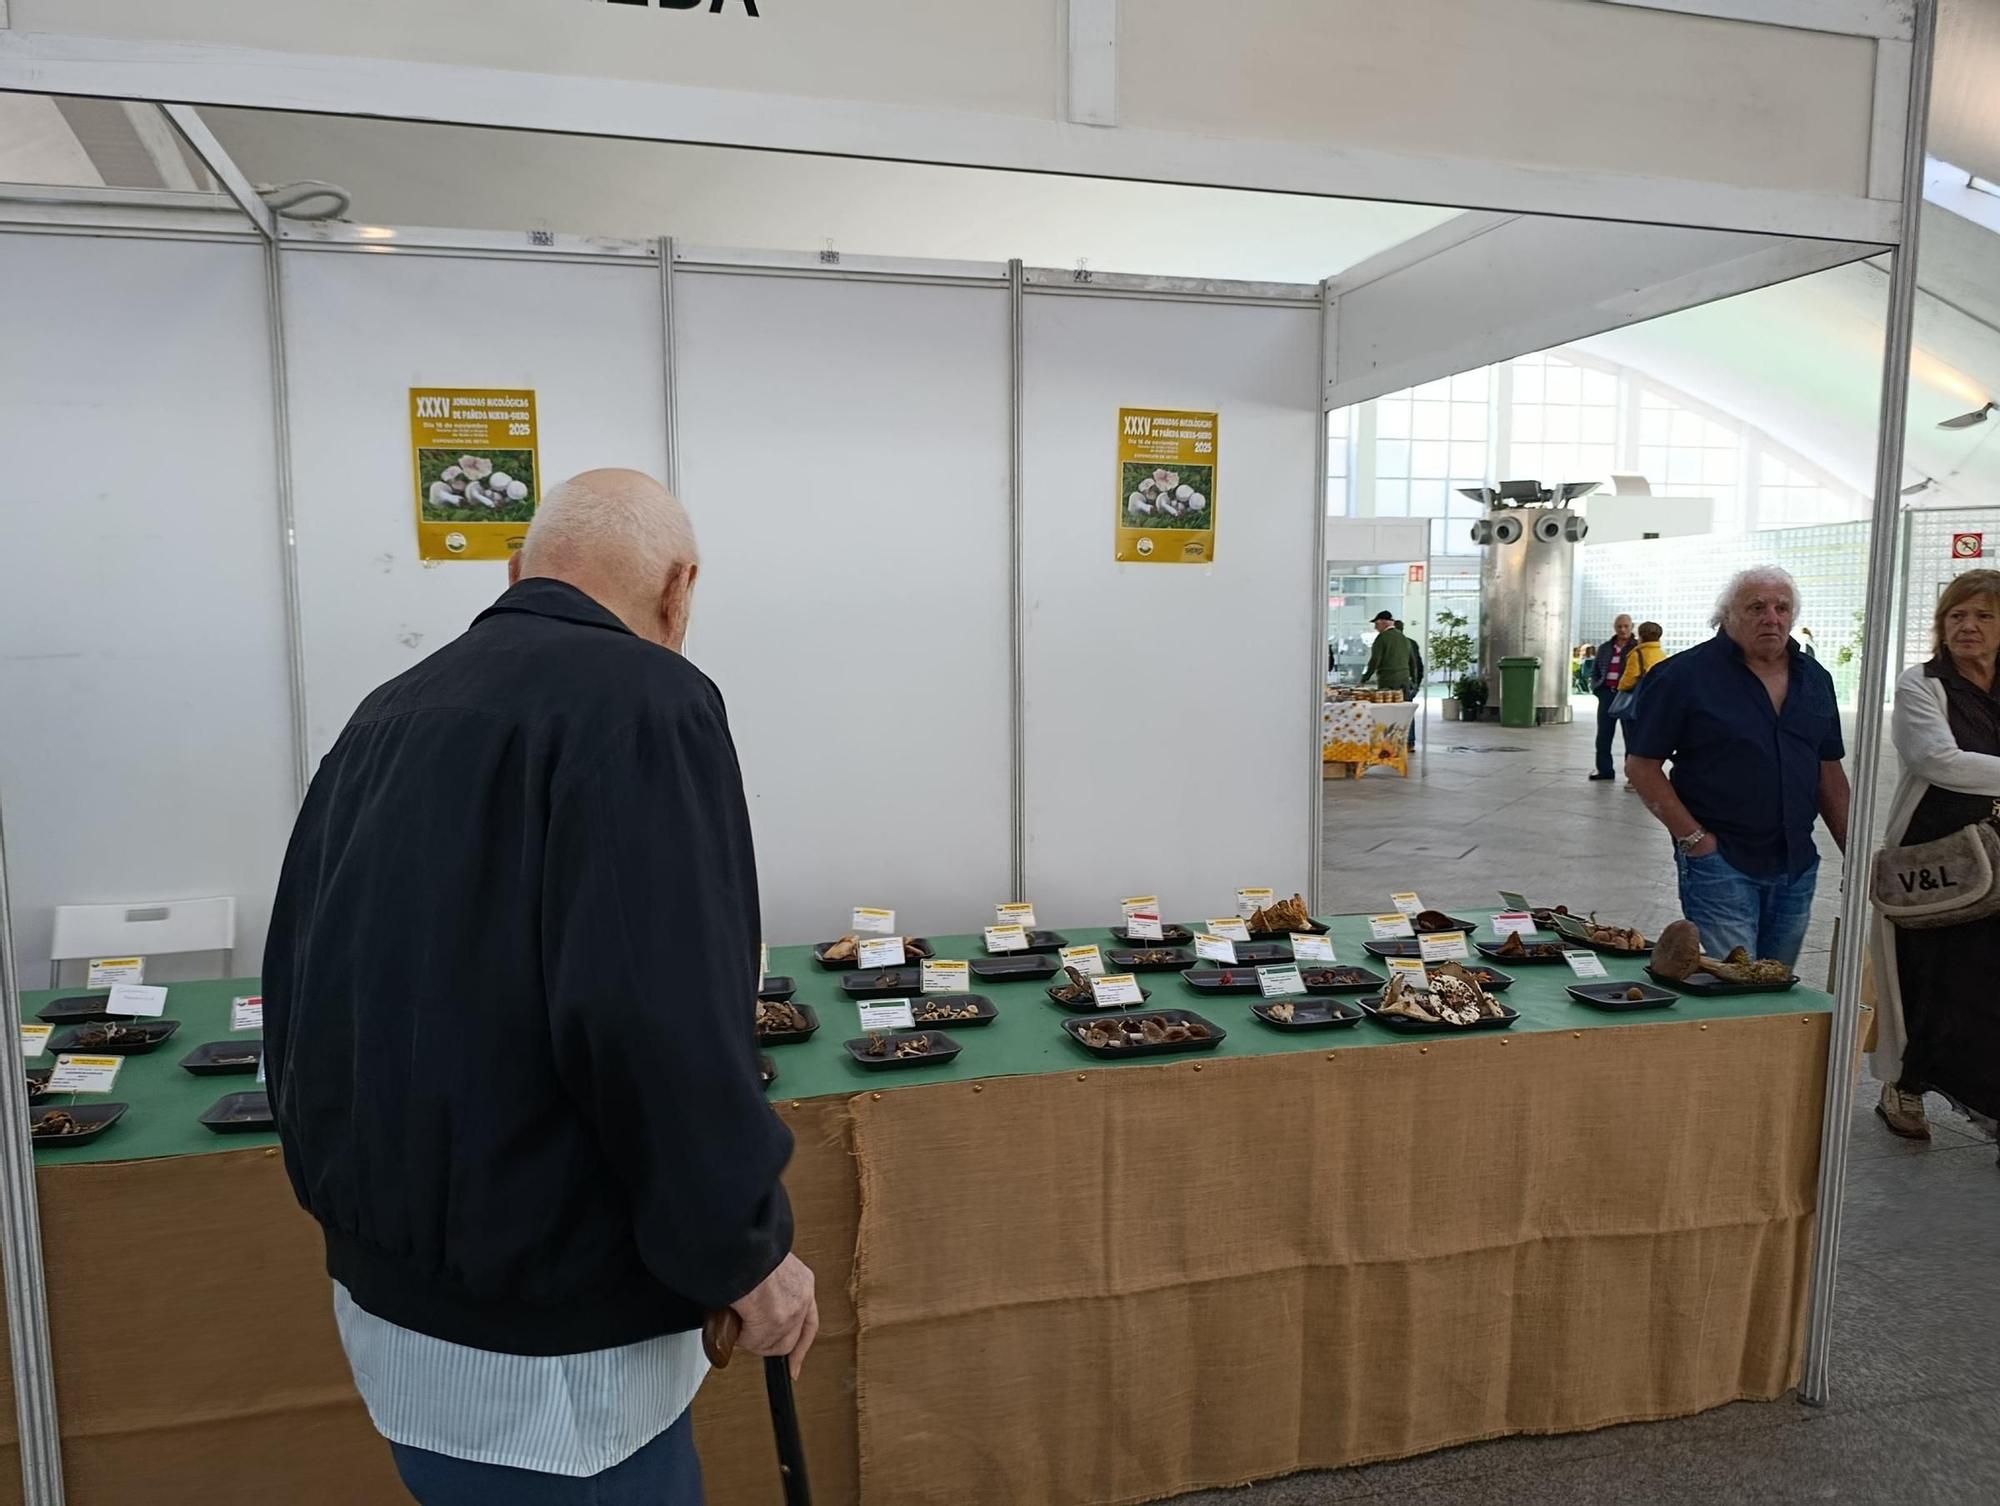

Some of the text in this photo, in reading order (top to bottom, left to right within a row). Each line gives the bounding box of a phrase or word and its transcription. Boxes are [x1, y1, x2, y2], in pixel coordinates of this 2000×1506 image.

[416, 397, 450, 418] XXXV
[509, 423, 531, 436] 2025
[1124, 416, 1151, 435] XXXV
[1897, 866, 1958, 893] V&L
